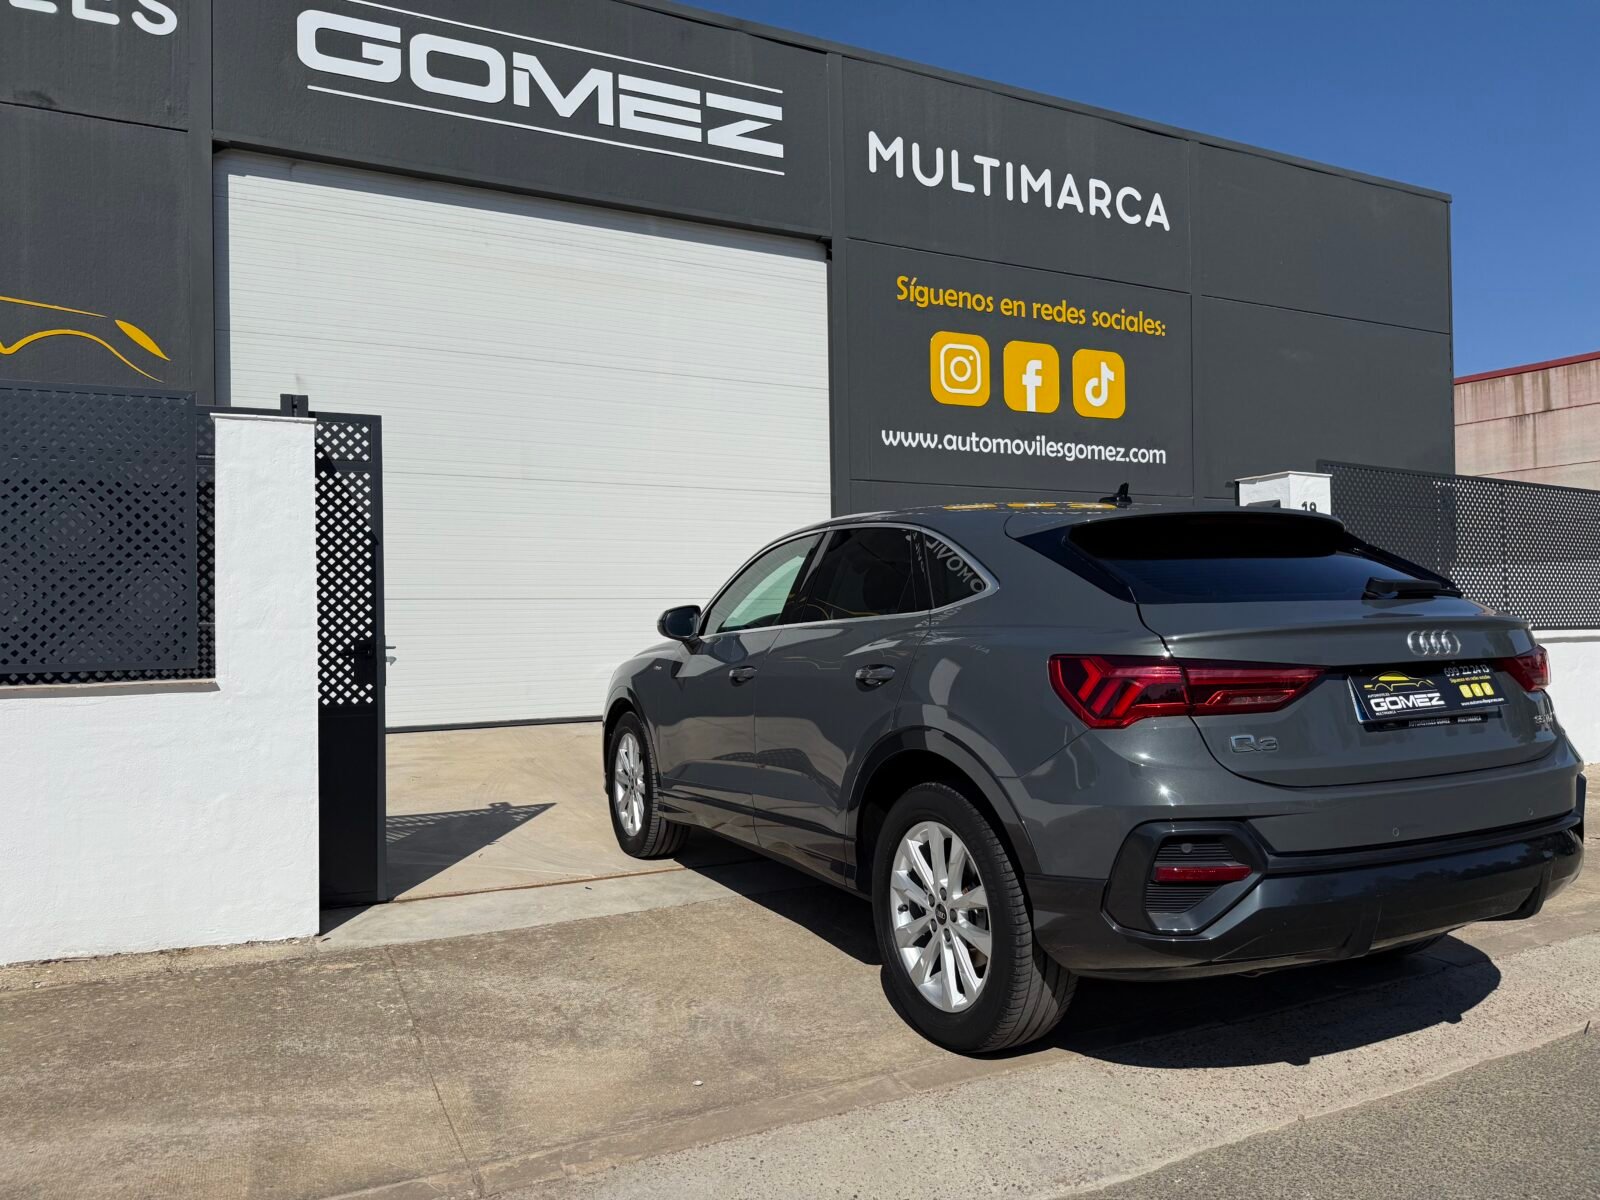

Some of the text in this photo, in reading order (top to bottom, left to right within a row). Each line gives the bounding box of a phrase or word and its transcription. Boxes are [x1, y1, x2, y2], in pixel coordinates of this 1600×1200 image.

[297, 9, 784, 159] GOMEZ
[868, 131, 1170, 232] MULTIMARCA
[897, 276, 1166, 337] Síguenos en redes sociales:
[882, 429, 1166, 464] www.automovilesgomez.com
[1370, 692, 1445, 712] GOMEZ
[1230, 734, 1278, 753] Q3
